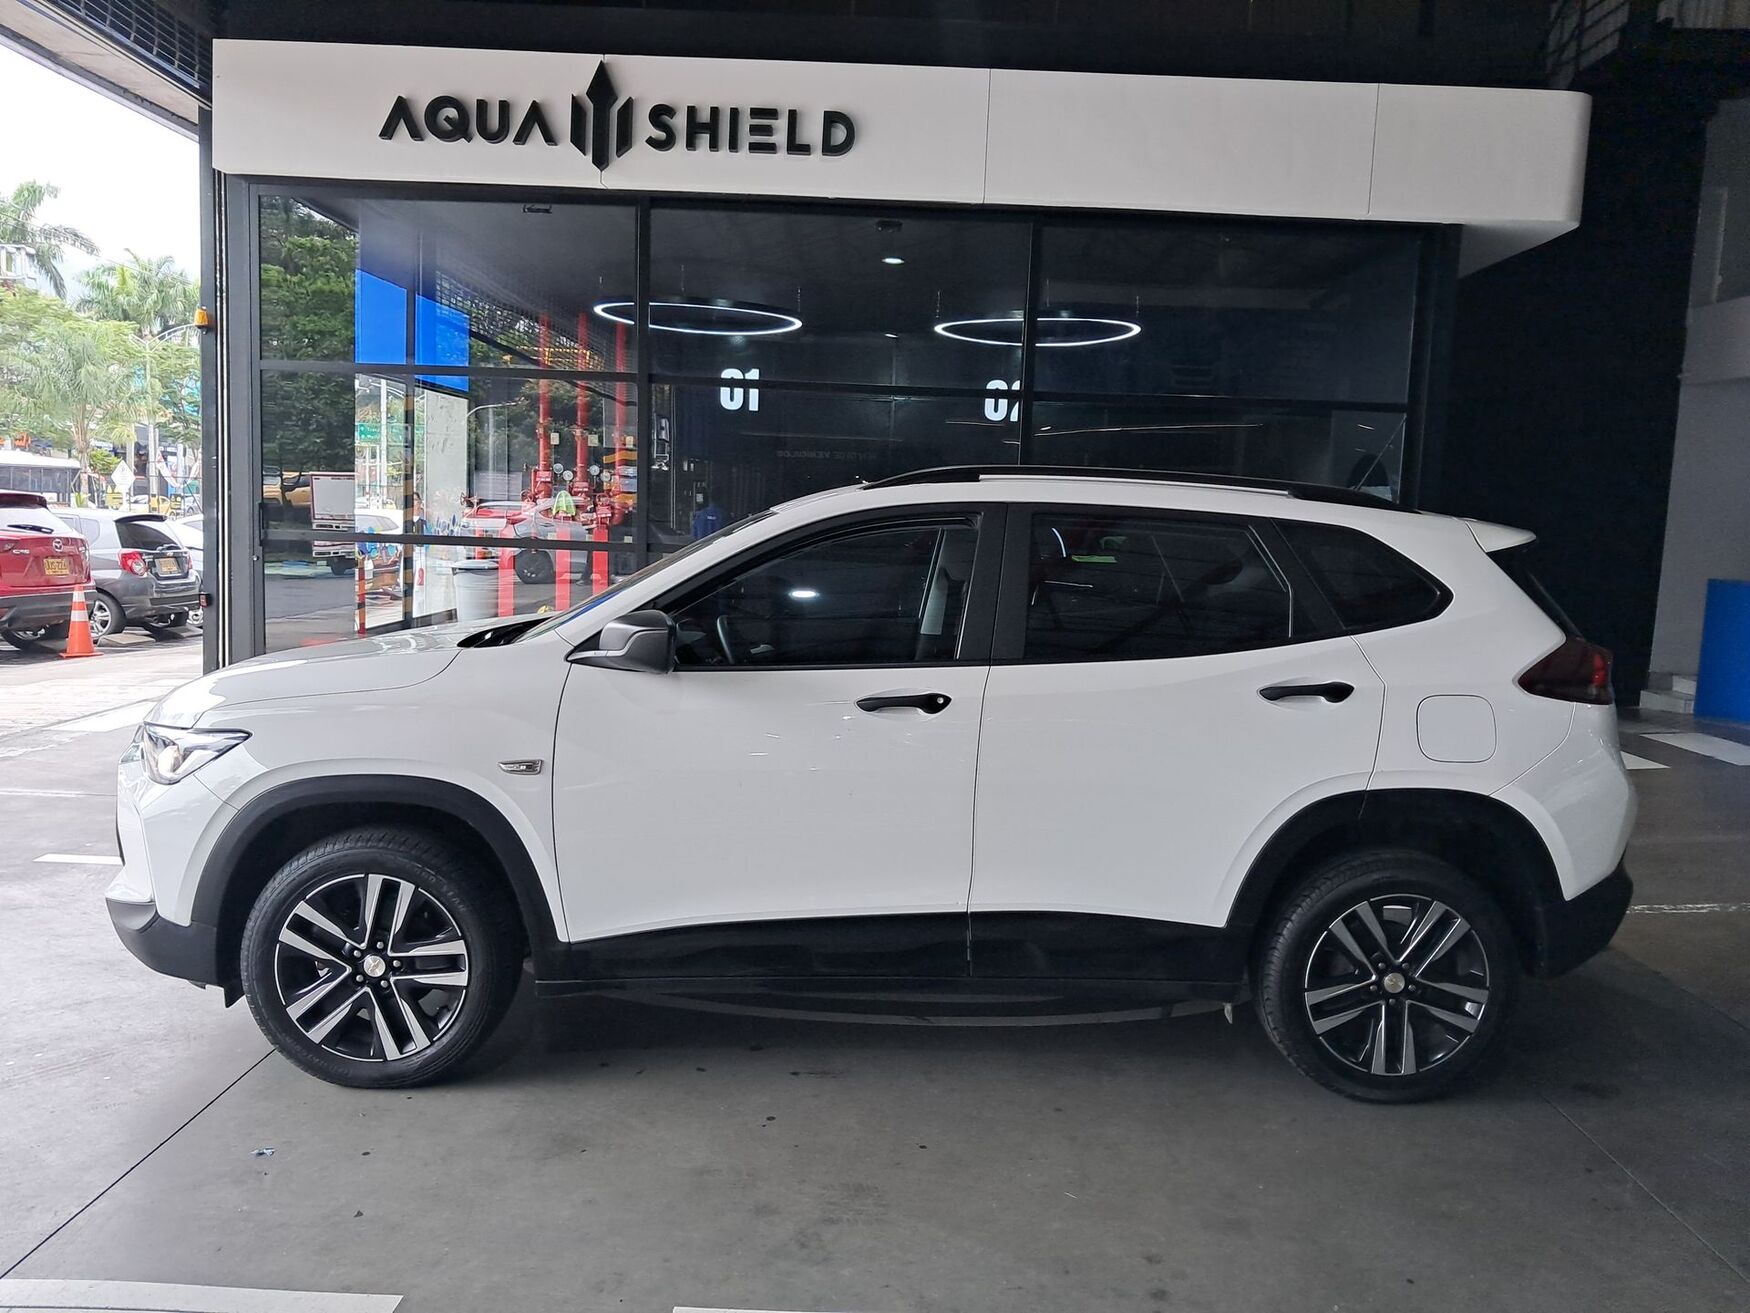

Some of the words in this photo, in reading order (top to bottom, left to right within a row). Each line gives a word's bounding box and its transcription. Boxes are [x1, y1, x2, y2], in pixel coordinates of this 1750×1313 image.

[379, 95, 558, 147] AQUA
[645, 103, 856, 158] SHIELD
[719, 368, 760, 411] 01
